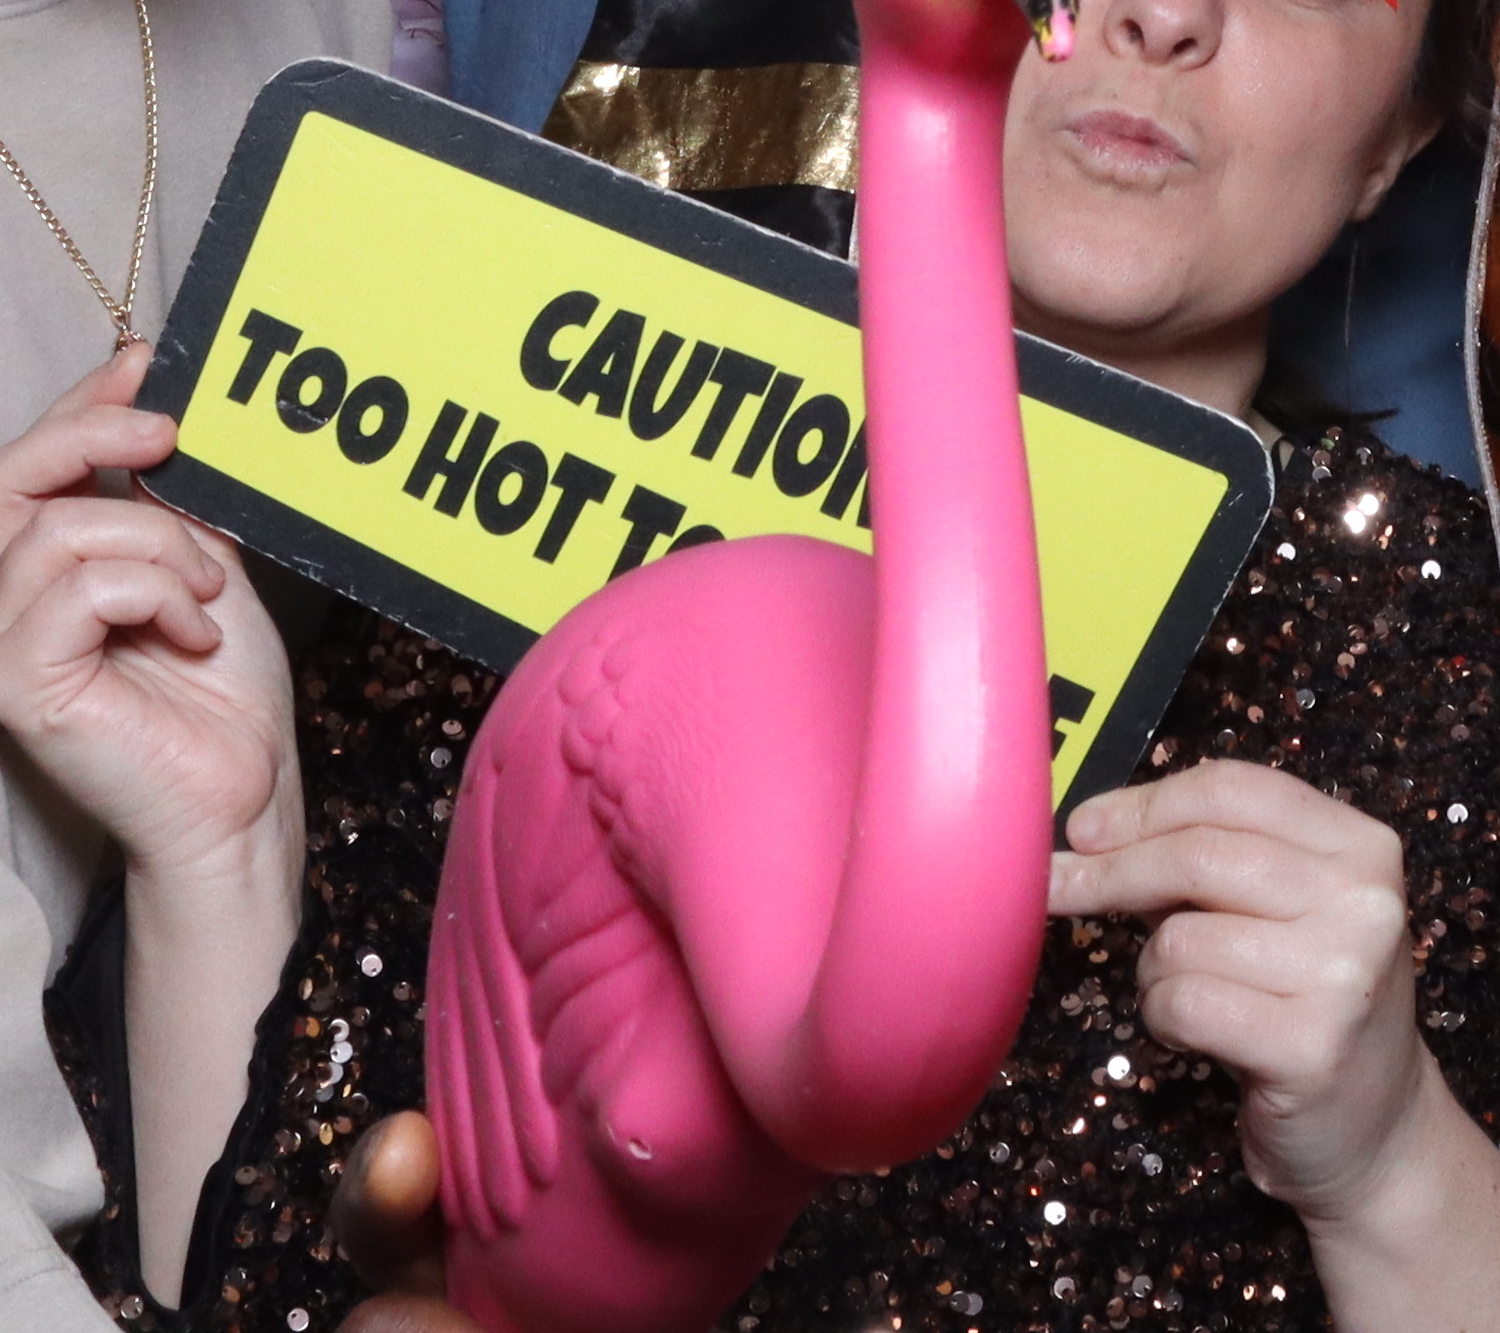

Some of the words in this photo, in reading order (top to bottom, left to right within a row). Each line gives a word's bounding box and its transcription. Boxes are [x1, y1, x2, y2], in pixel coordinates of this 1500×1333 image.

[226, 308, 409, 465] TOO
[402, 399, 616, 565] HOT
[605, 484, 726, 585] T
